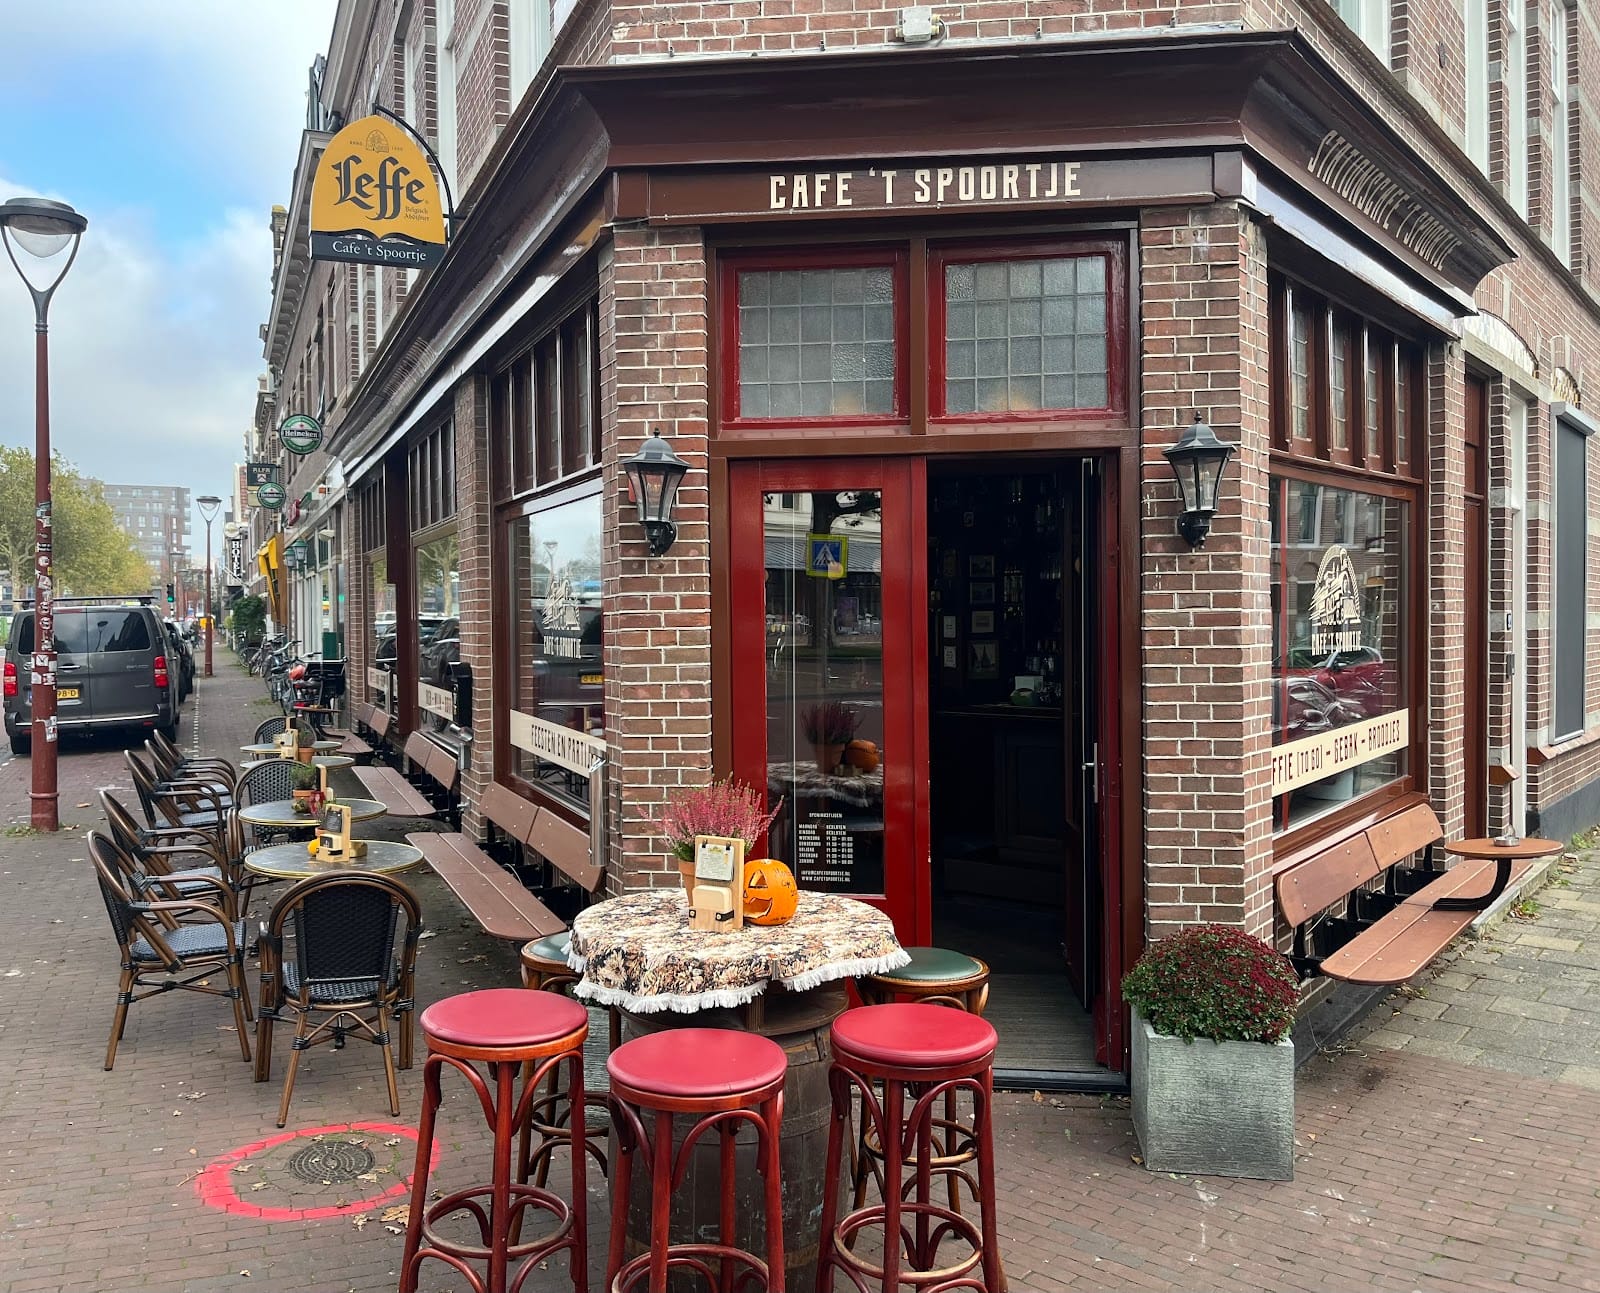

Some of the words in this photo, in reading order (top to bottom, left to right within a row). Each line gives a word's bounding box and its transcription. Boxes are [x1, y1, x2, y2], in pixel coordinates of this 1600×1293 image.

[331, 155, 425, 221] Leffe
[770, 172, 853, 209] CAFE
[868, 167, 897, 204] 'T
[914, 162, 1081, 203] SPOORTJE
[332, 241, 361, 255] Cafe
[376, 245, 427, 262] Spoortje
[1403, 211, 1462, 272] SPOORTJE
[285, 430, 318, 438] Heineken
[231, 540, 241, 578] HOTEL
[531, 724, 555, 755] FEESTEN
[557, 733, 566, 759] EN
[1334, 732, 1358, 764] GEBAK
